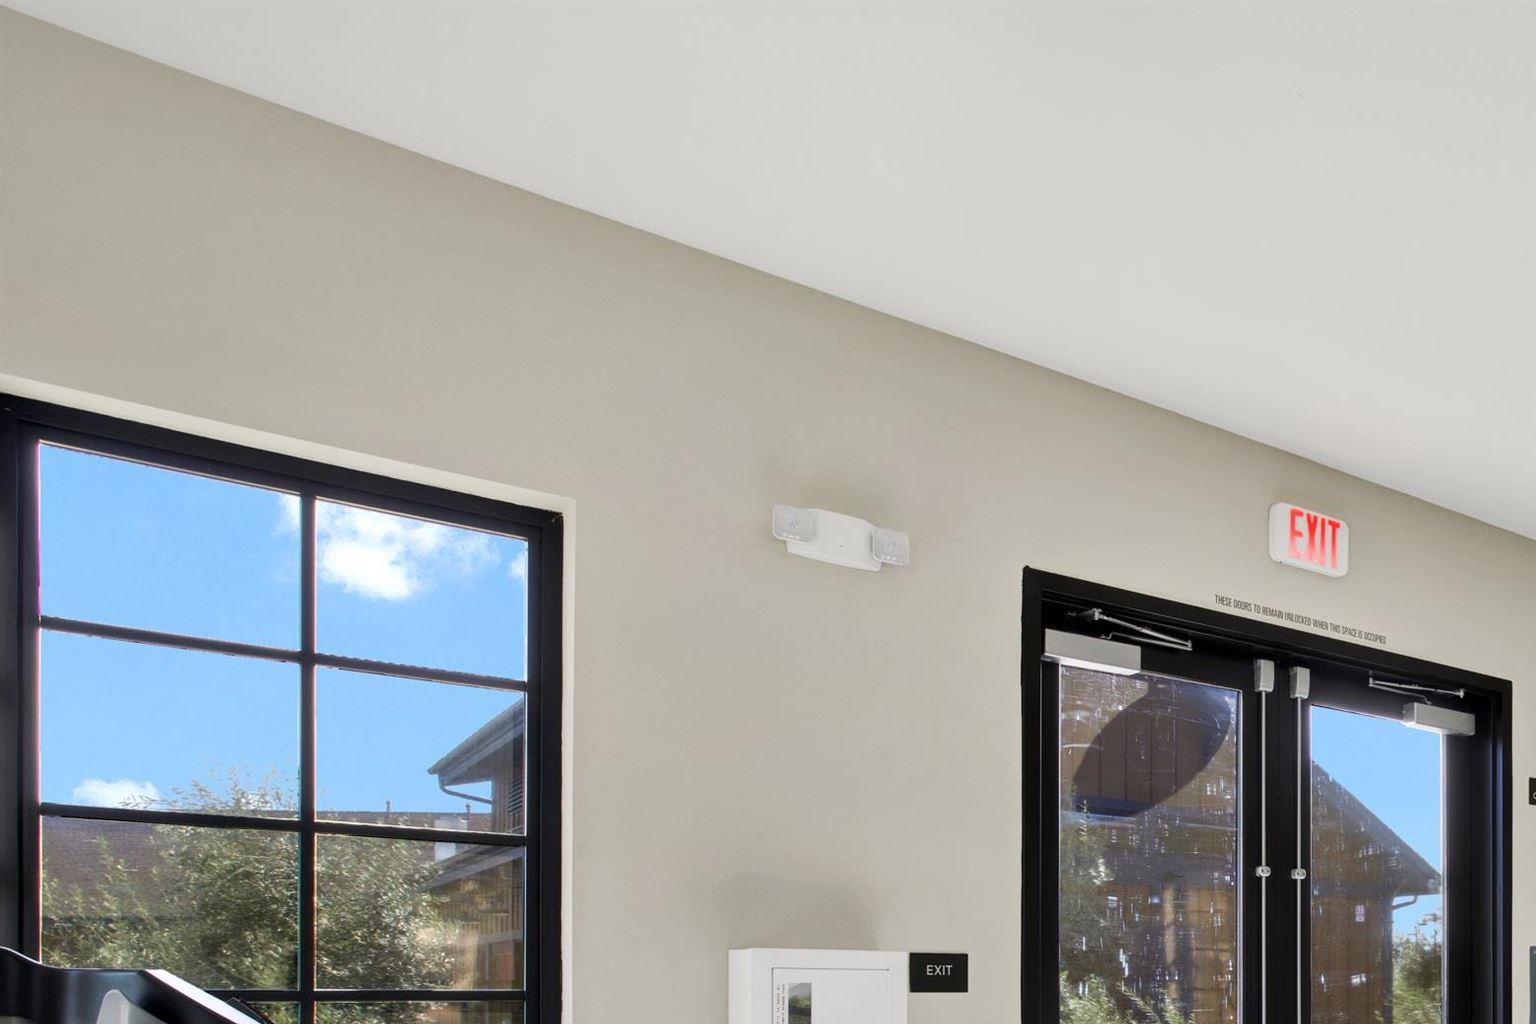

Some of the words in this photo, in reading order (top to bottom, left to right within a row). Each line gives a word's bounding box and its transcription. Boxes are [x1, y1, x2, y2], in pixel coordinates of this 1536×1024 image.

[1288, 507, 1341, 568] EXIT
[1215, 594, 1232, 607] THESE
[1233, 599, 1252, 612] DOORS
[1254, 604, 1261, 614] TO
[1262, 606, 1283, 619] REMAIN
[1285, 612, 1311, 626] UNLOCKED
[1313, 618, 1328, 630] WHEN
[1330, 622, 1340, 633] THIS
[1342, 626, 1357, 638] SPACE
[1364, 632, 1386, 644] OCCUPIED
[926, 965, 953, 976] EXIT
